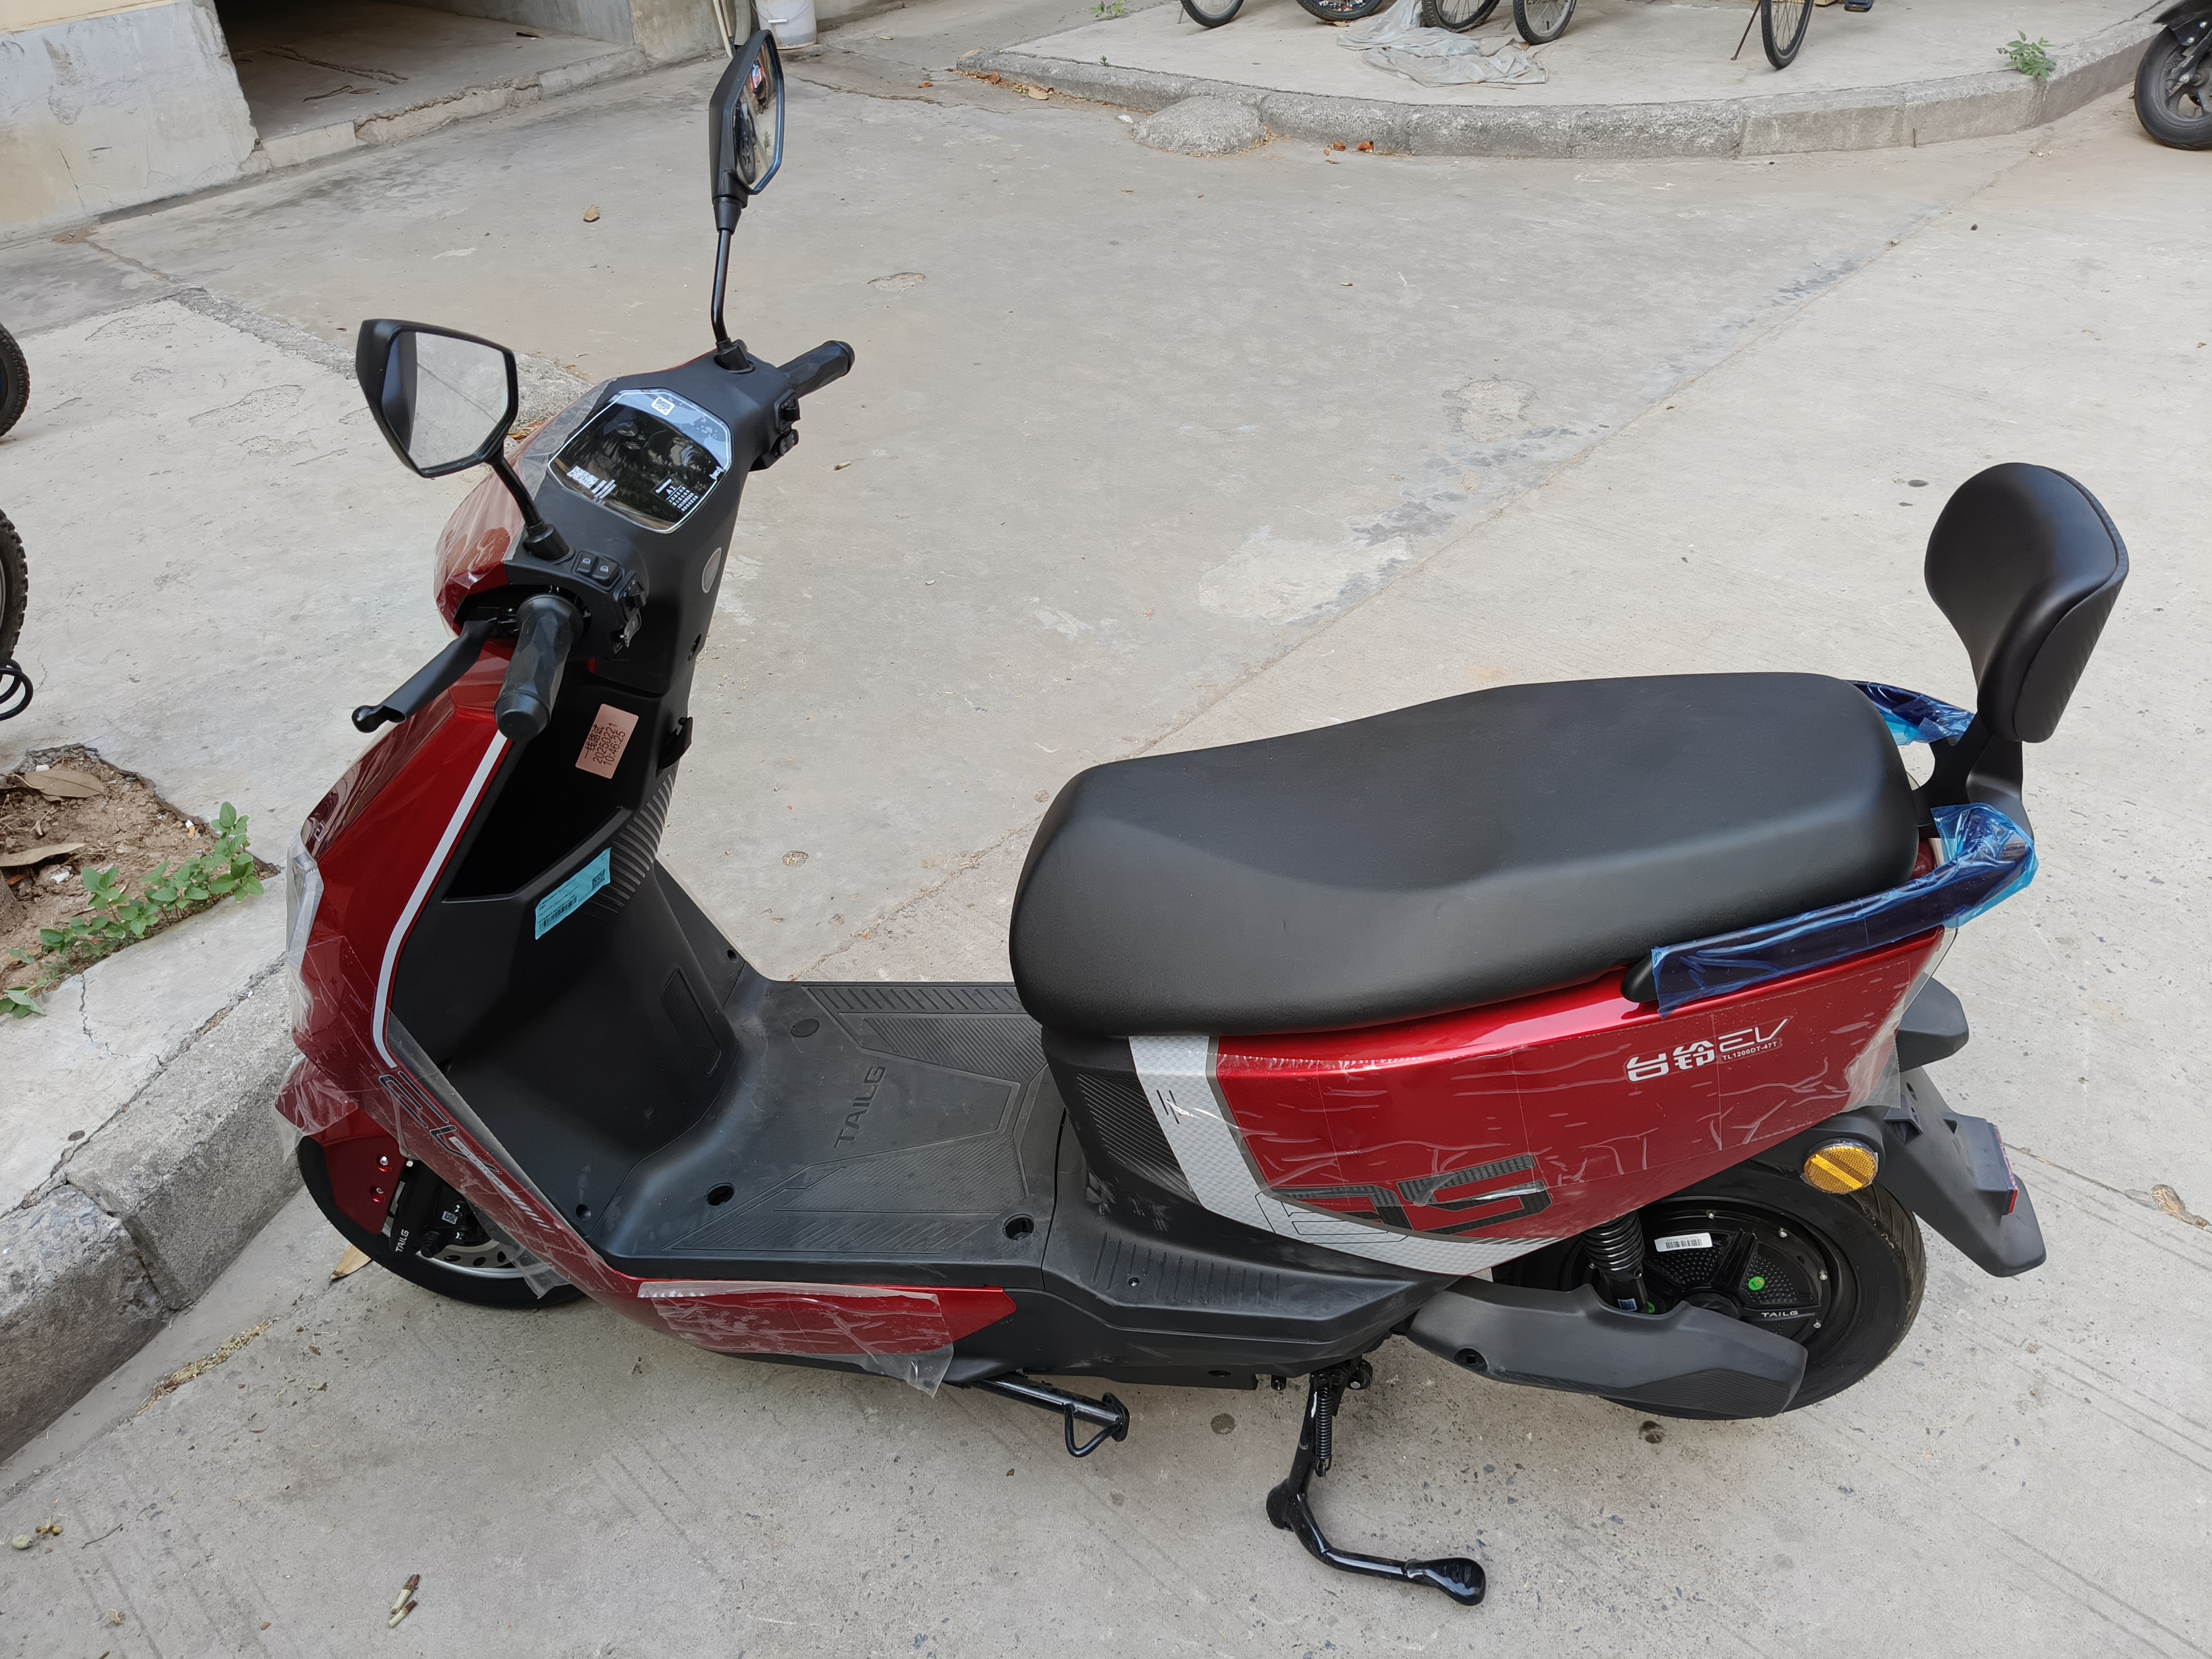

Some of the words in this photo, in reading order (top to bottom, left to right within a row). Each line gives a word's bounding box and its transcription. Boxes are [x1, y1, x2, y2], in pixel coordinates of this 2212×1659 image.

[593, 722, 618, 764] 20250221
[603, 731, 626, 766] 10:46:25
[1722, 1041, 1778, 1061] TL1200DT-47T
[833, 1066, 886, 1149] TAILG
[395, 1229, 409, 1253] TAILG
[1761, 1310, 1799, 1318] TAILG
